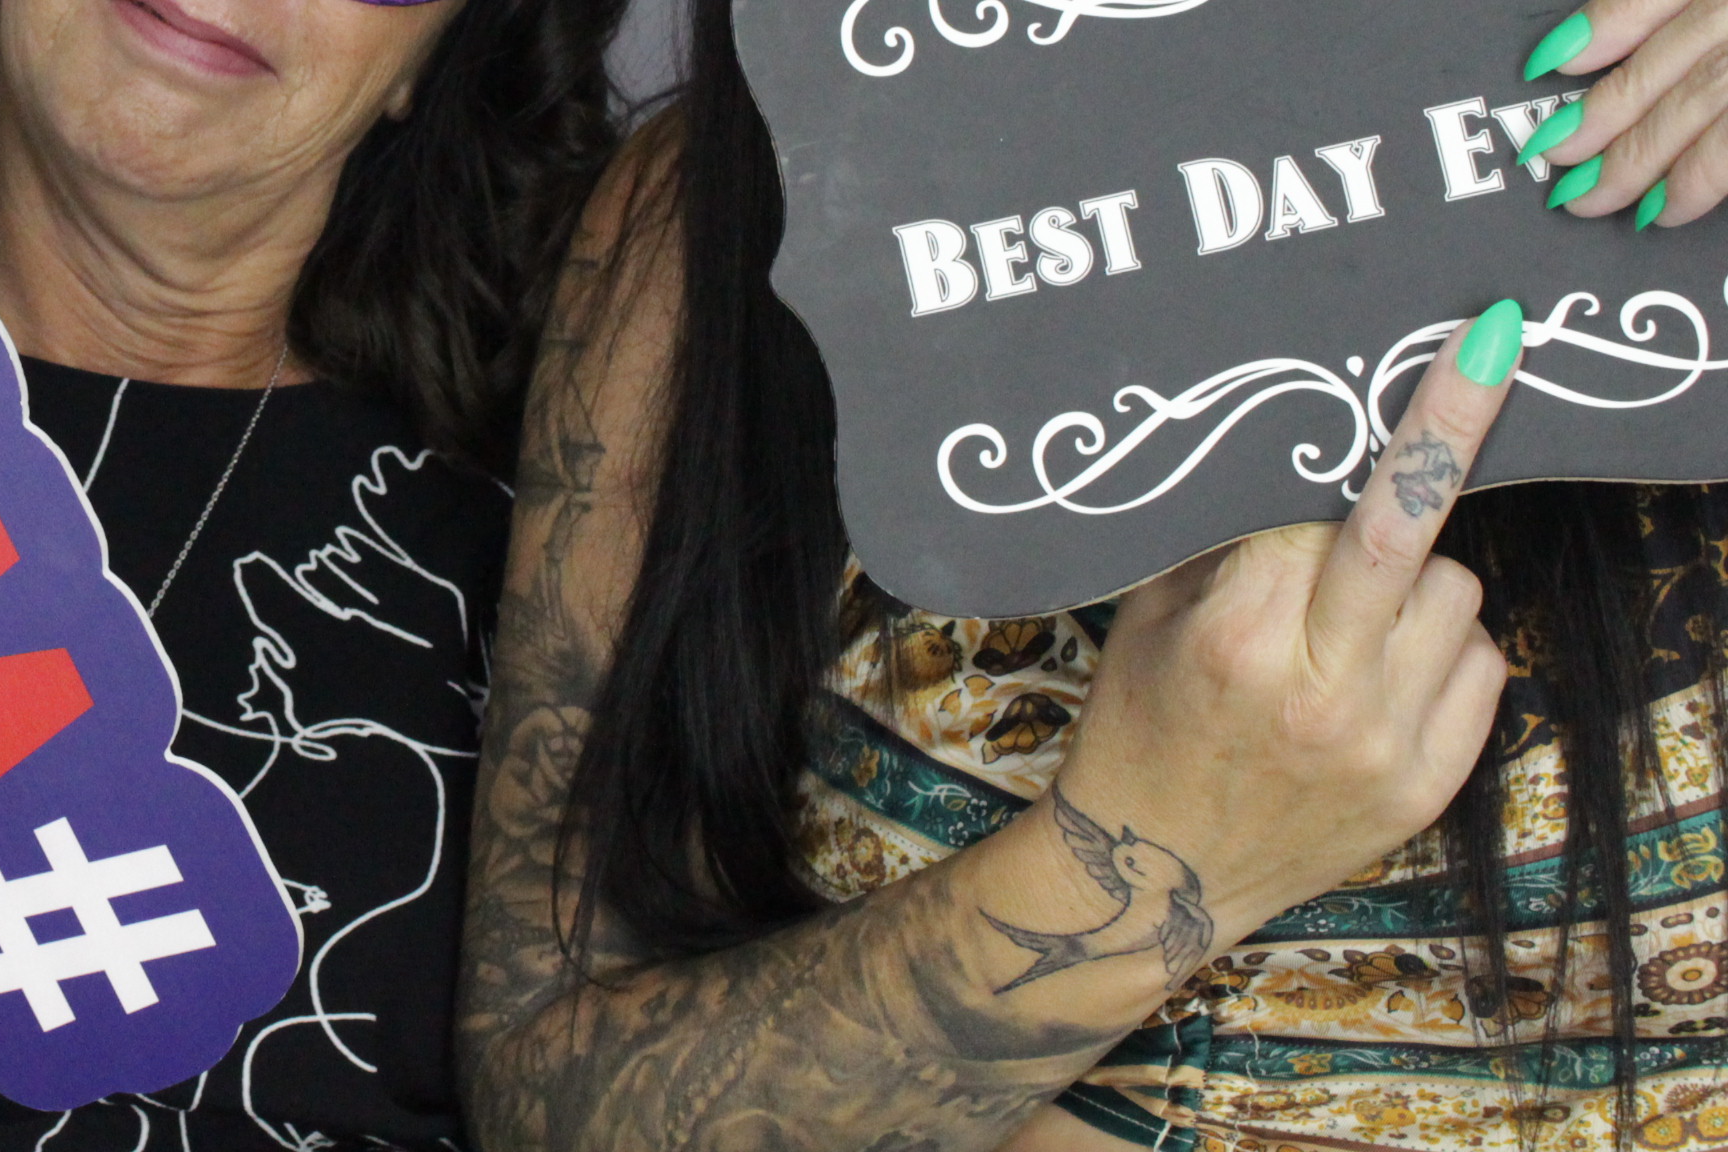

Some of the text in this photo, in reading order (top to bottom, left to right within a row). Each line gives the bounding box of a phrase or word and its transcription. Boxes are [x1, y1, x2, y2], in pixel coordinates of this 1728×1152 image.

[892, 89, 1589, 318] BEST DAY EV
